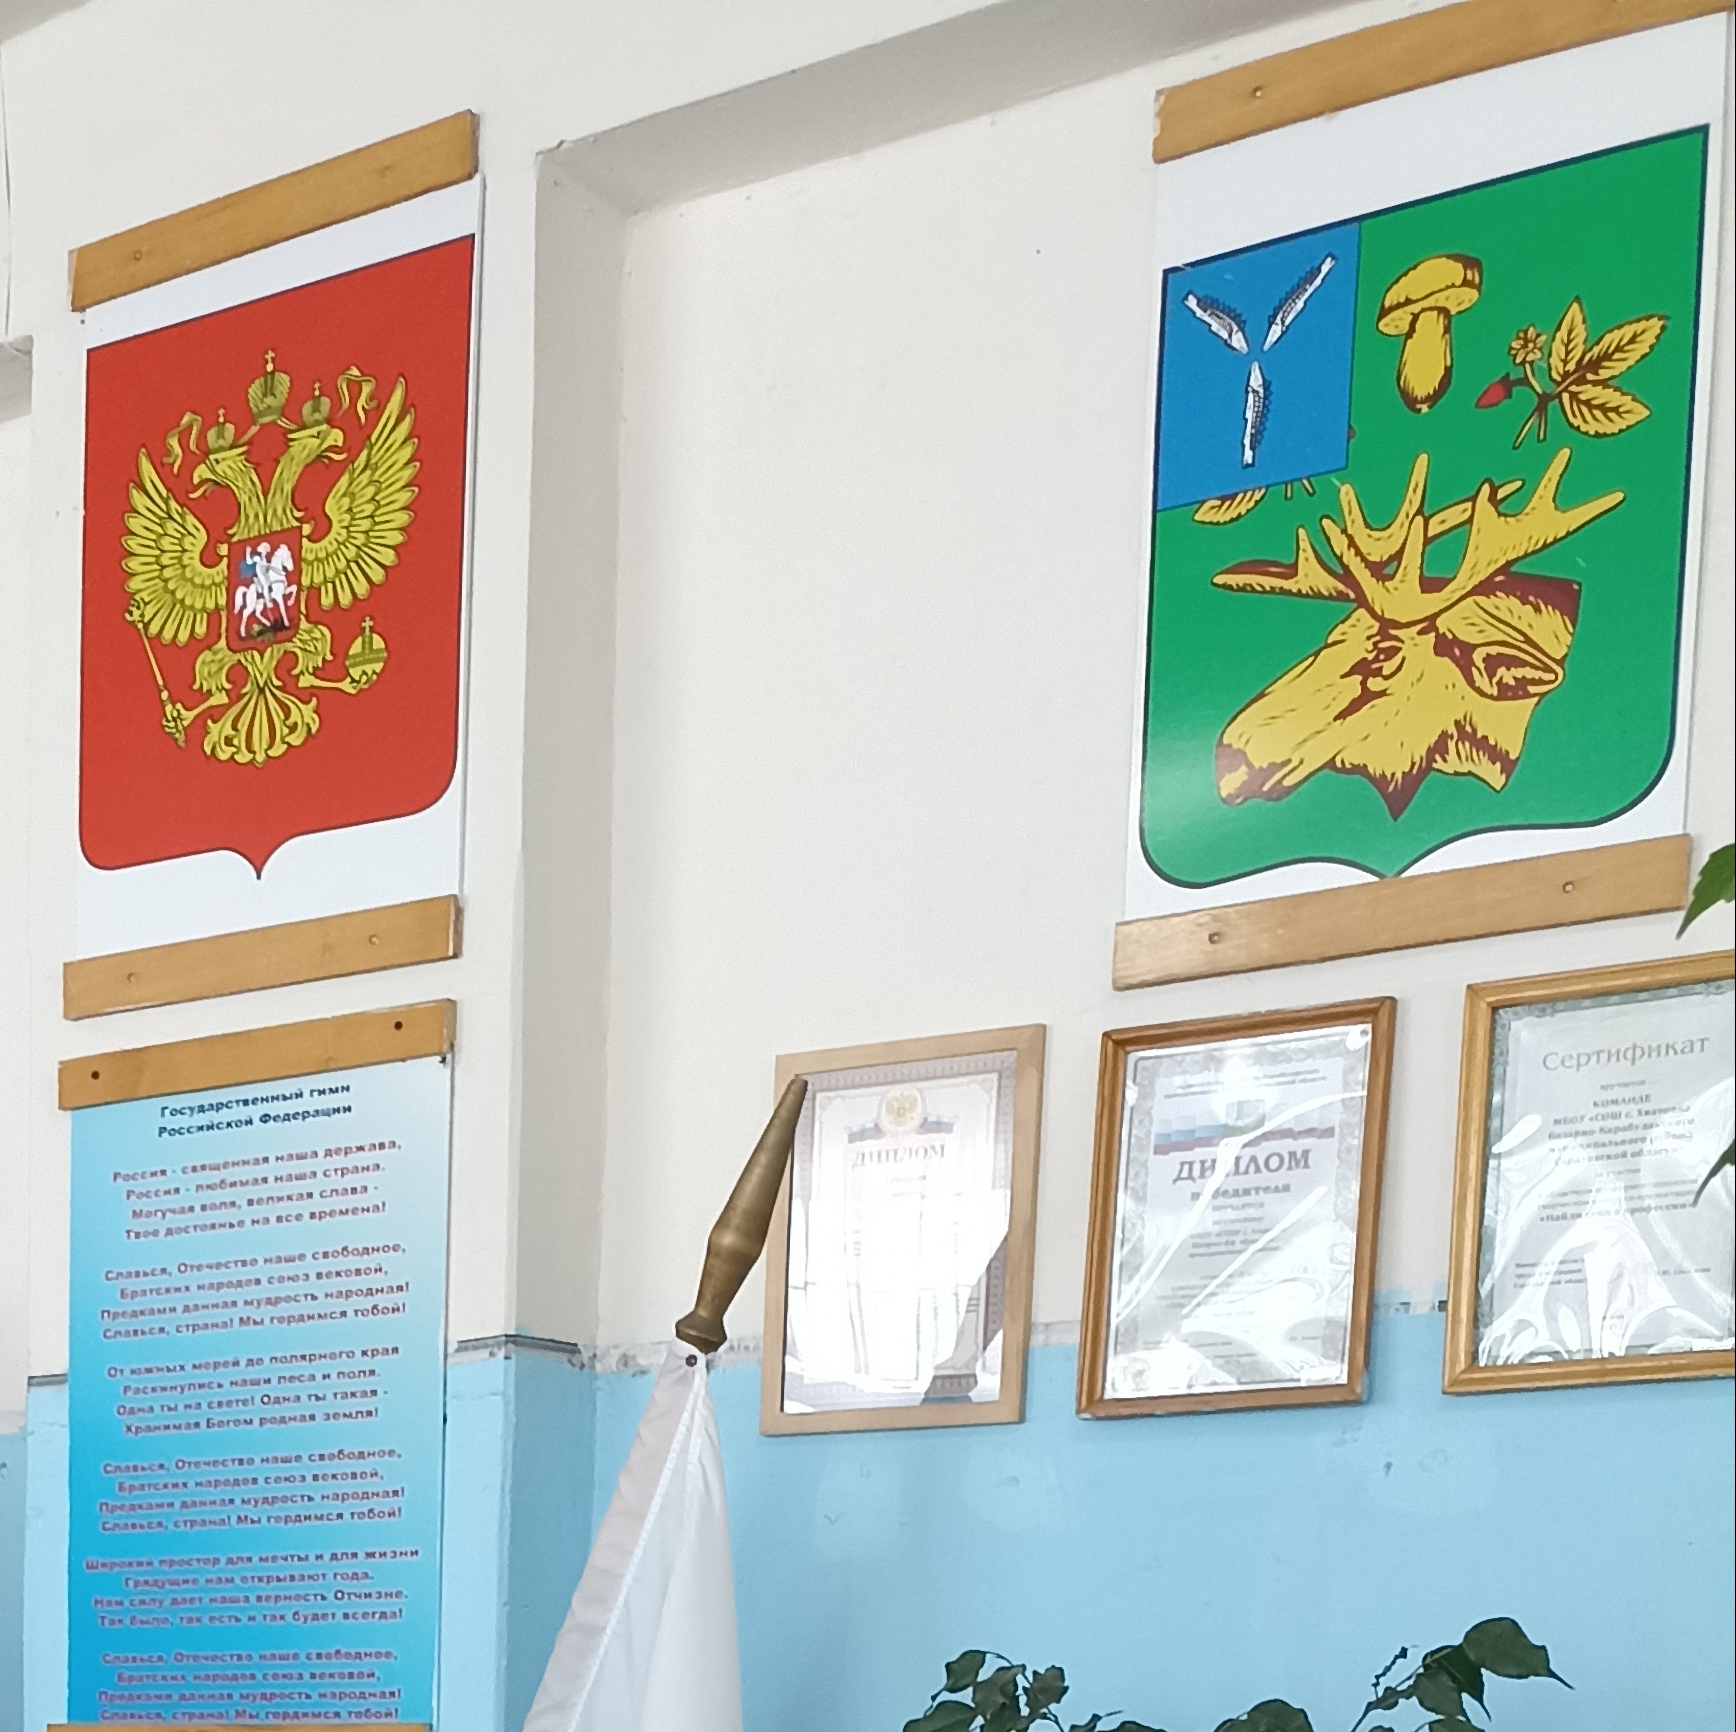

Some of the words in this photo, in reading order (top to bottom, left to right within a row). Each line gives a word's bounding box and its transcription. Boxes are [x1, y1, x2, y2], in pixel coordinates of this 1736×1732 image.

[1542, 1037, 1711, 1072] Сертификат
[159, 1087, 304, 1118] Государственный
[308, 1083, 351, 1098] гимн
[156, 1115, 254, 1138] Российской
[257, 1103, 353, 1124] Федерации
[851, 1143, 946, 1169] ДИПЛОМ
